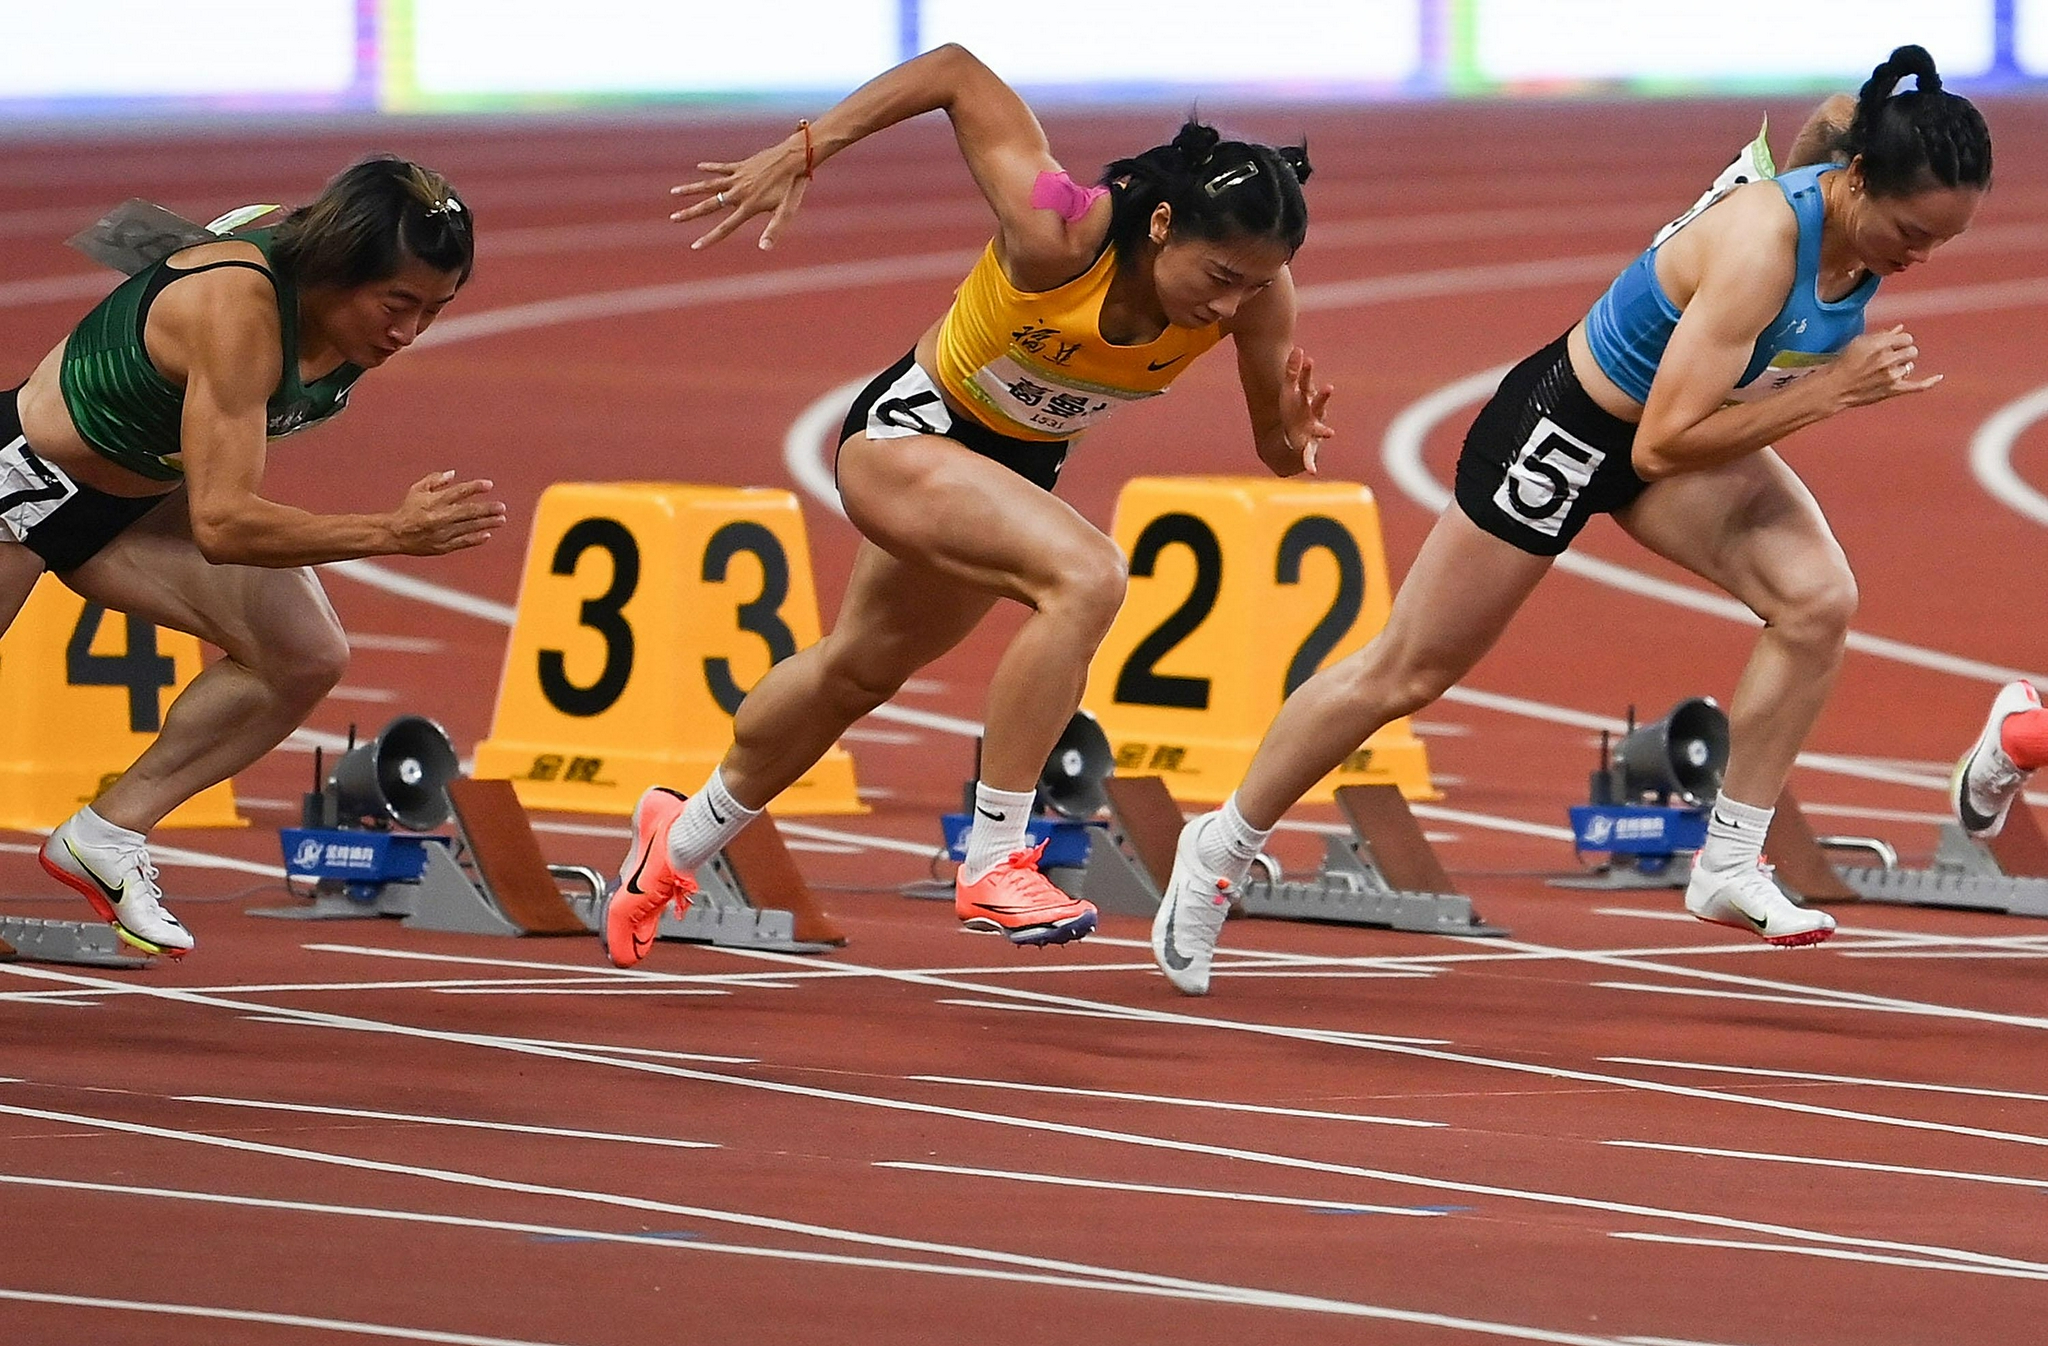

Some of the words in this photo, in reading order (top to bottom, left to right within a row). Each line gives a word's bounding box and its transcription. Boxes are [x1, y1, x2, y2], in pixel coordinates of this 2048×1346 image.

[875, 390, 941, 434] 6
[1008, 377, 1107, 419] 葛曼
[0, 443, 70, 516] 7
[1508, 431, 1593, 520] 5
[66, 600, 176, 733] 4
[537, 516, 640, 718] 3
[702, 519, 796, 717] 3
[1113, 512, 1223, 711] 2
[1275, 515, 1365, 703] 2
